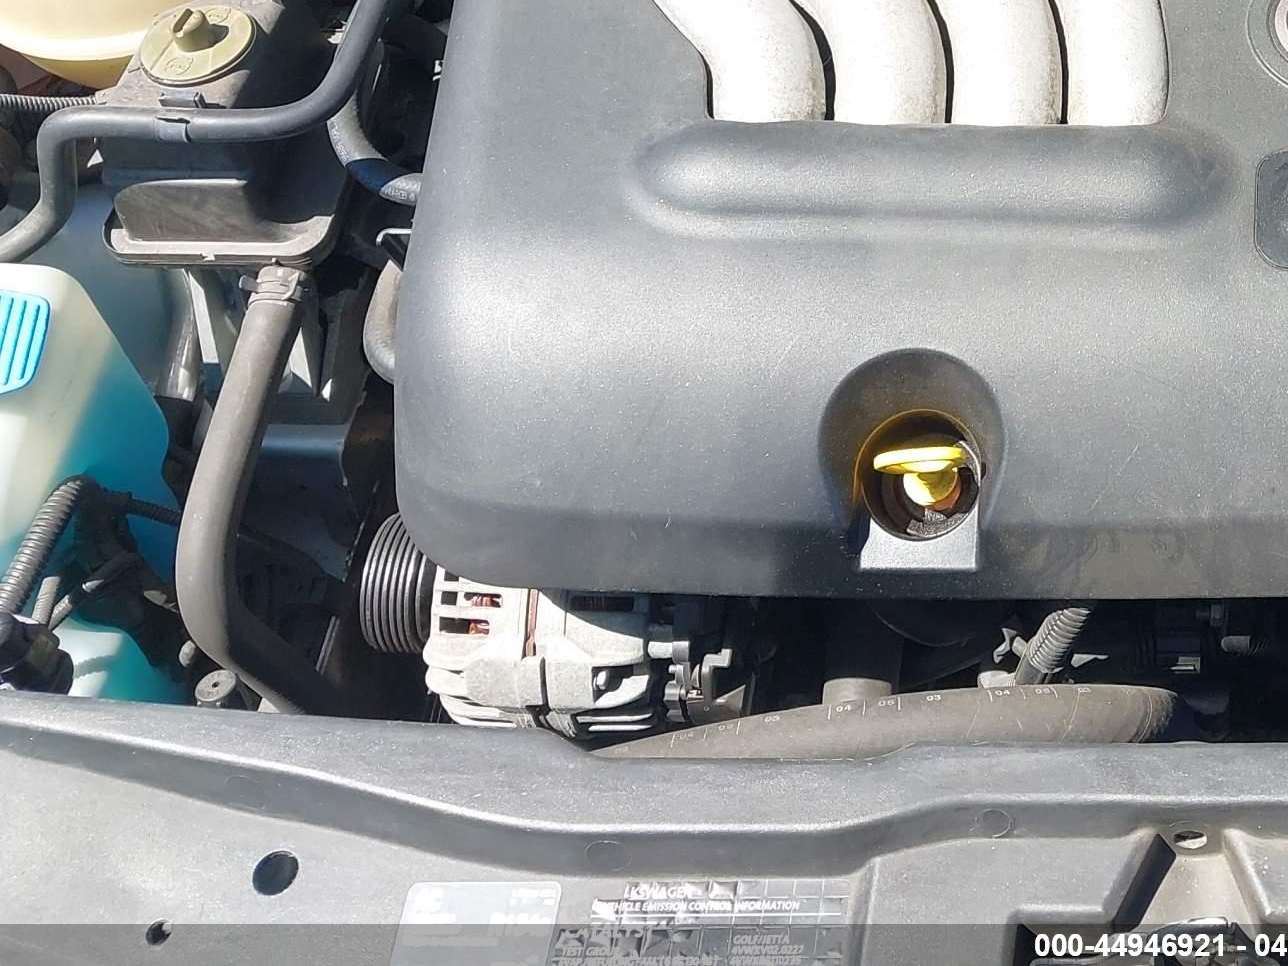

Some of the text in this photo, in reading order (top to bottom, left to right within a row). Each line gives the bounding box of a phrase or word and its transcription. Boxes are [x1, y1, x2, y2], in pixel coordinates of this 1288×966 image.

[642, 901, 687, 912] EMISSION
[735, 900, 800, 911] INFORMATION
[732, 934, 791, 945] GOLF/JETTA
